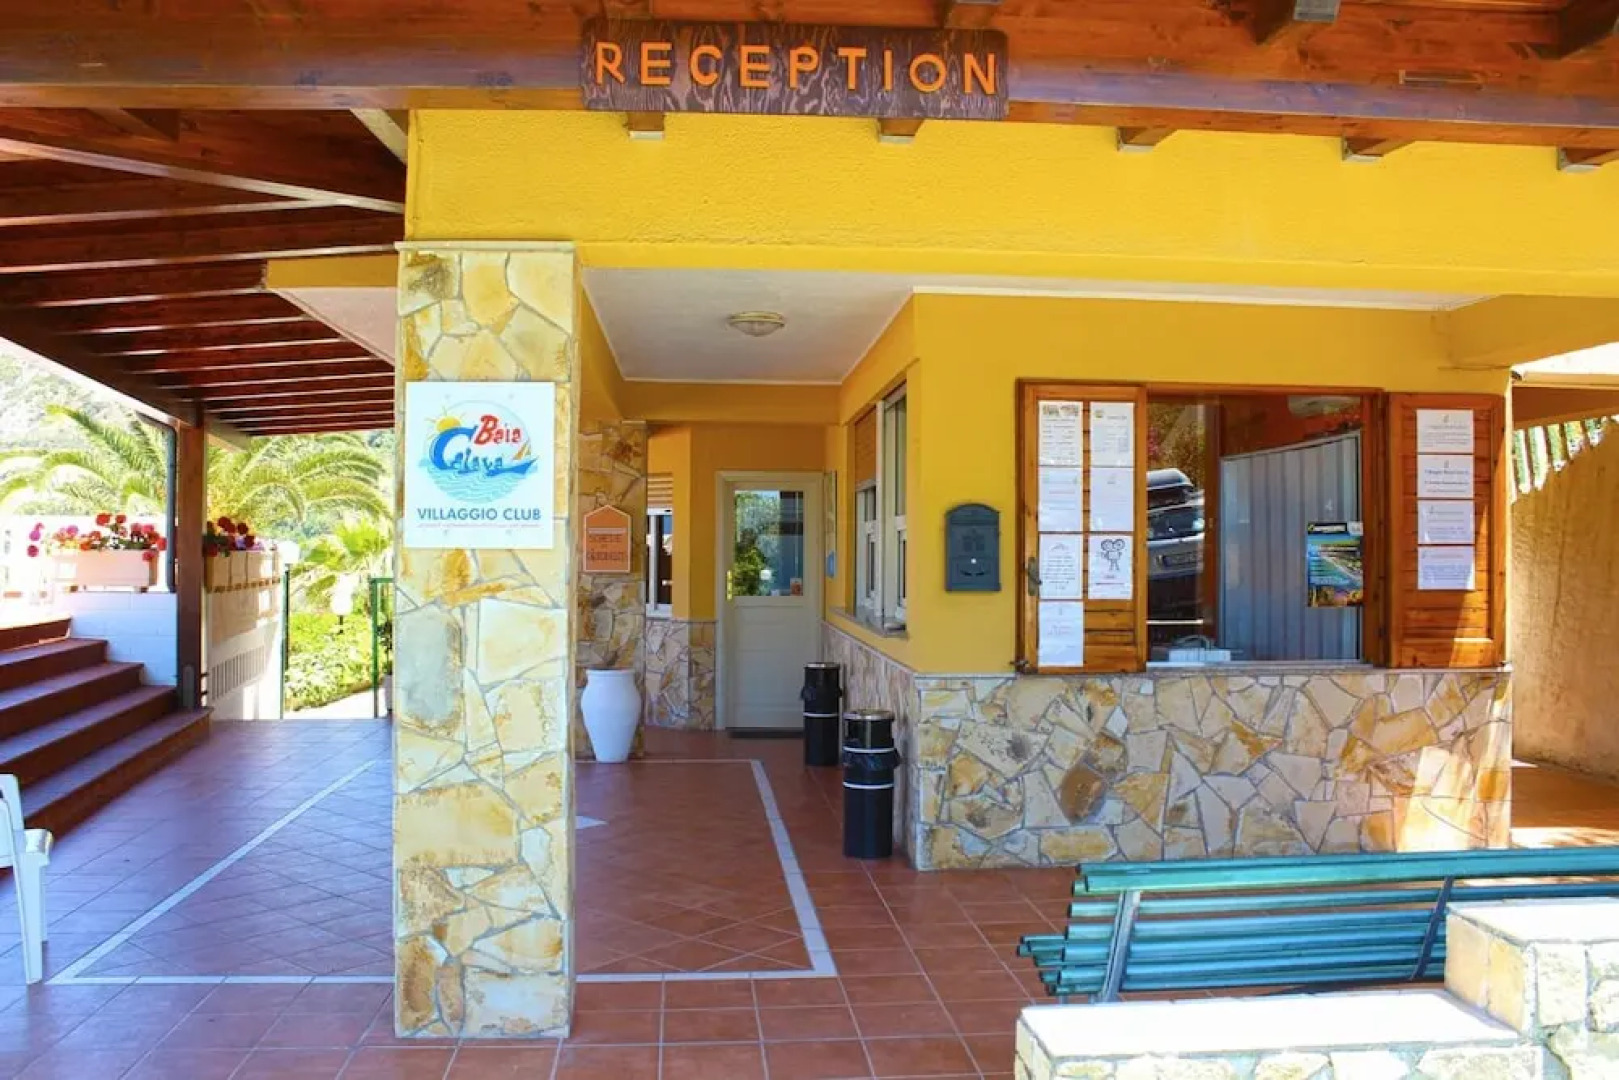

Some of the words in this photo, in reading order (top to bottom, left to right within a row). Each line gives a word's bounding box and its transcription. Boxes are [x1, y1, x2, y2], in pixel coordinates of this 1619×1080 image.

[594, 41, 996, 95] RECEPTION
[473, 414, 521, 446] Baia
[417, 507, 498, 521] VILLAGGIO
[503, 507, 542, 521] CLUB
